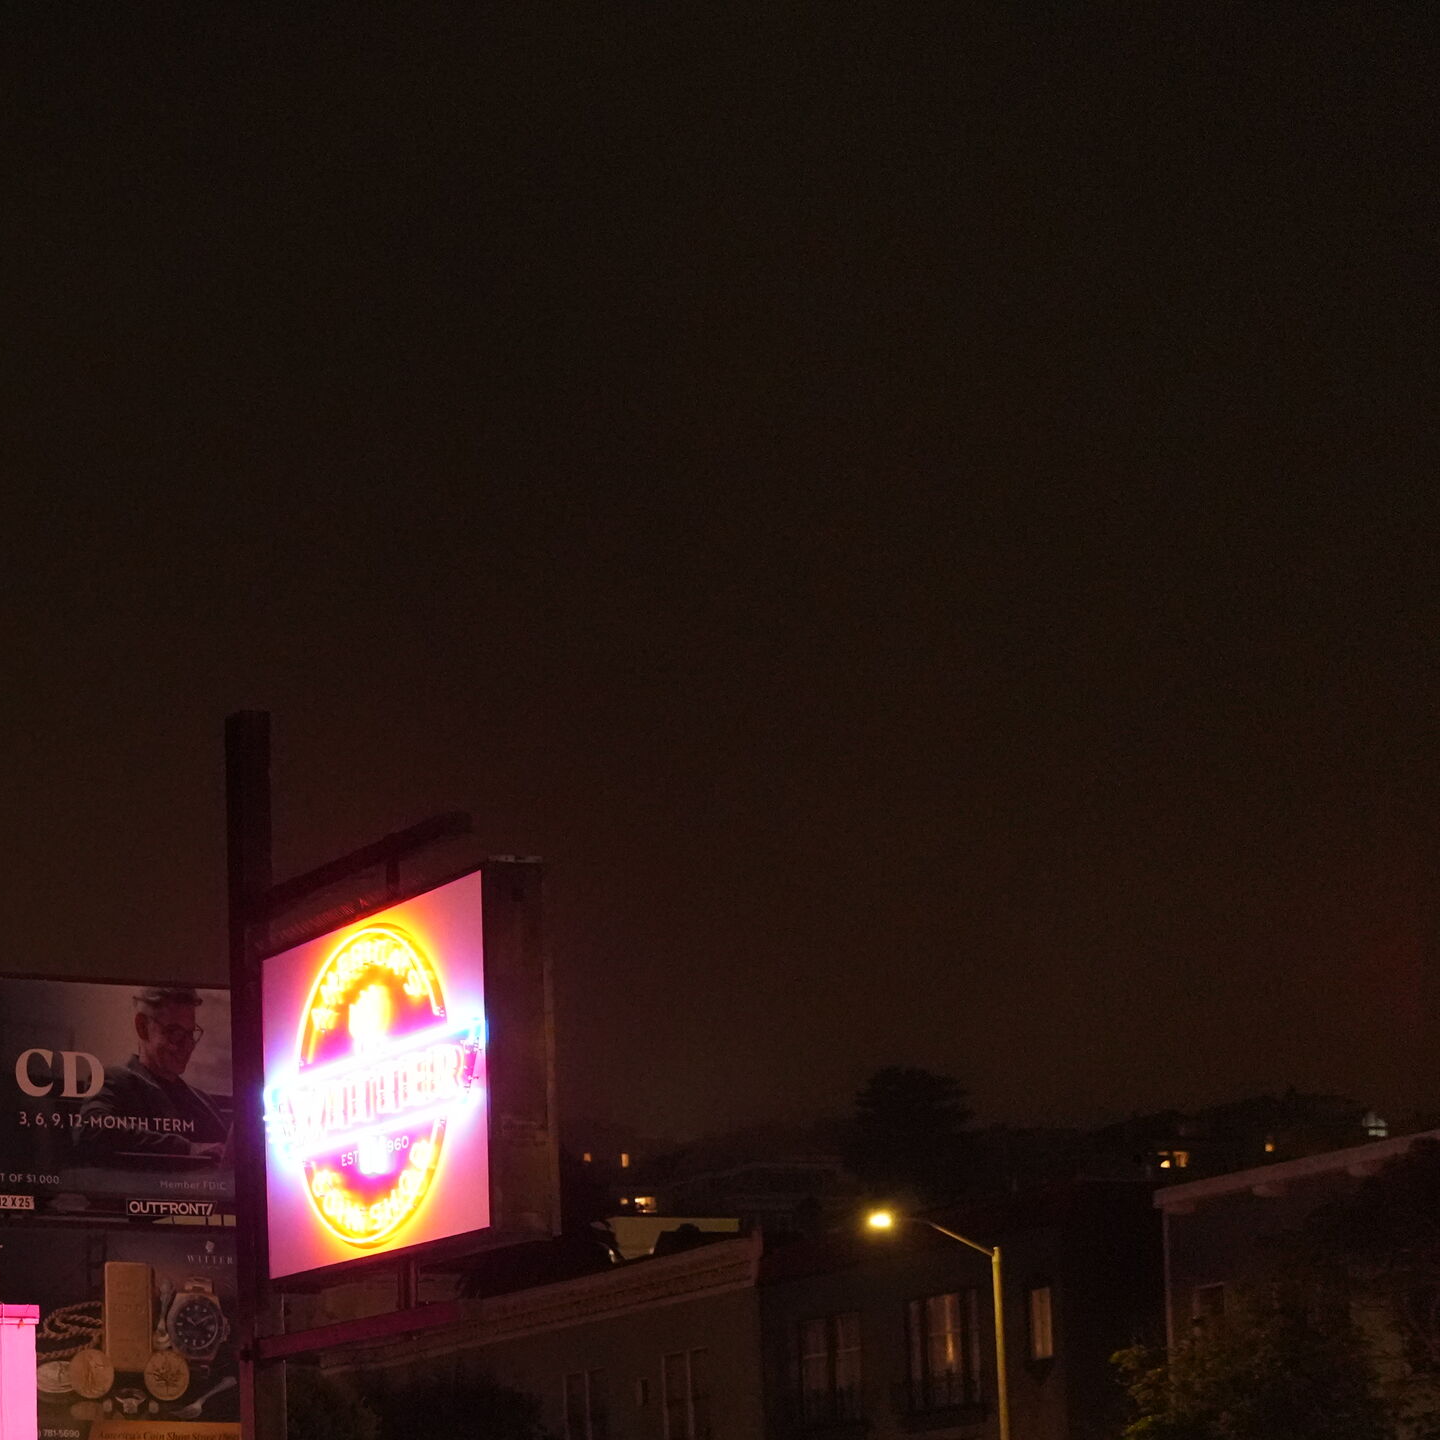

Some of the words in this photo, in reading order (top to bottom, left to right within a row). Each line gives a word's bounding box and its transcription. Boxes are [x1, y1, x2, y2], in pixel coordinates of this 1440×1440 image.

[16, 1048, 105, 1098] CD
[19, 1111, 31, 1127] 3,
[35, 1113, 48, 1128] 6,
[52, 1114, 64, 1128] 9,
[70, 1114, 148, 1132] 12-MONTH
[153, 1117, 194, 1132] TERM
[9, 1173, 23, 1183] OF
[187, 1255, 234, 1265] WITTER
